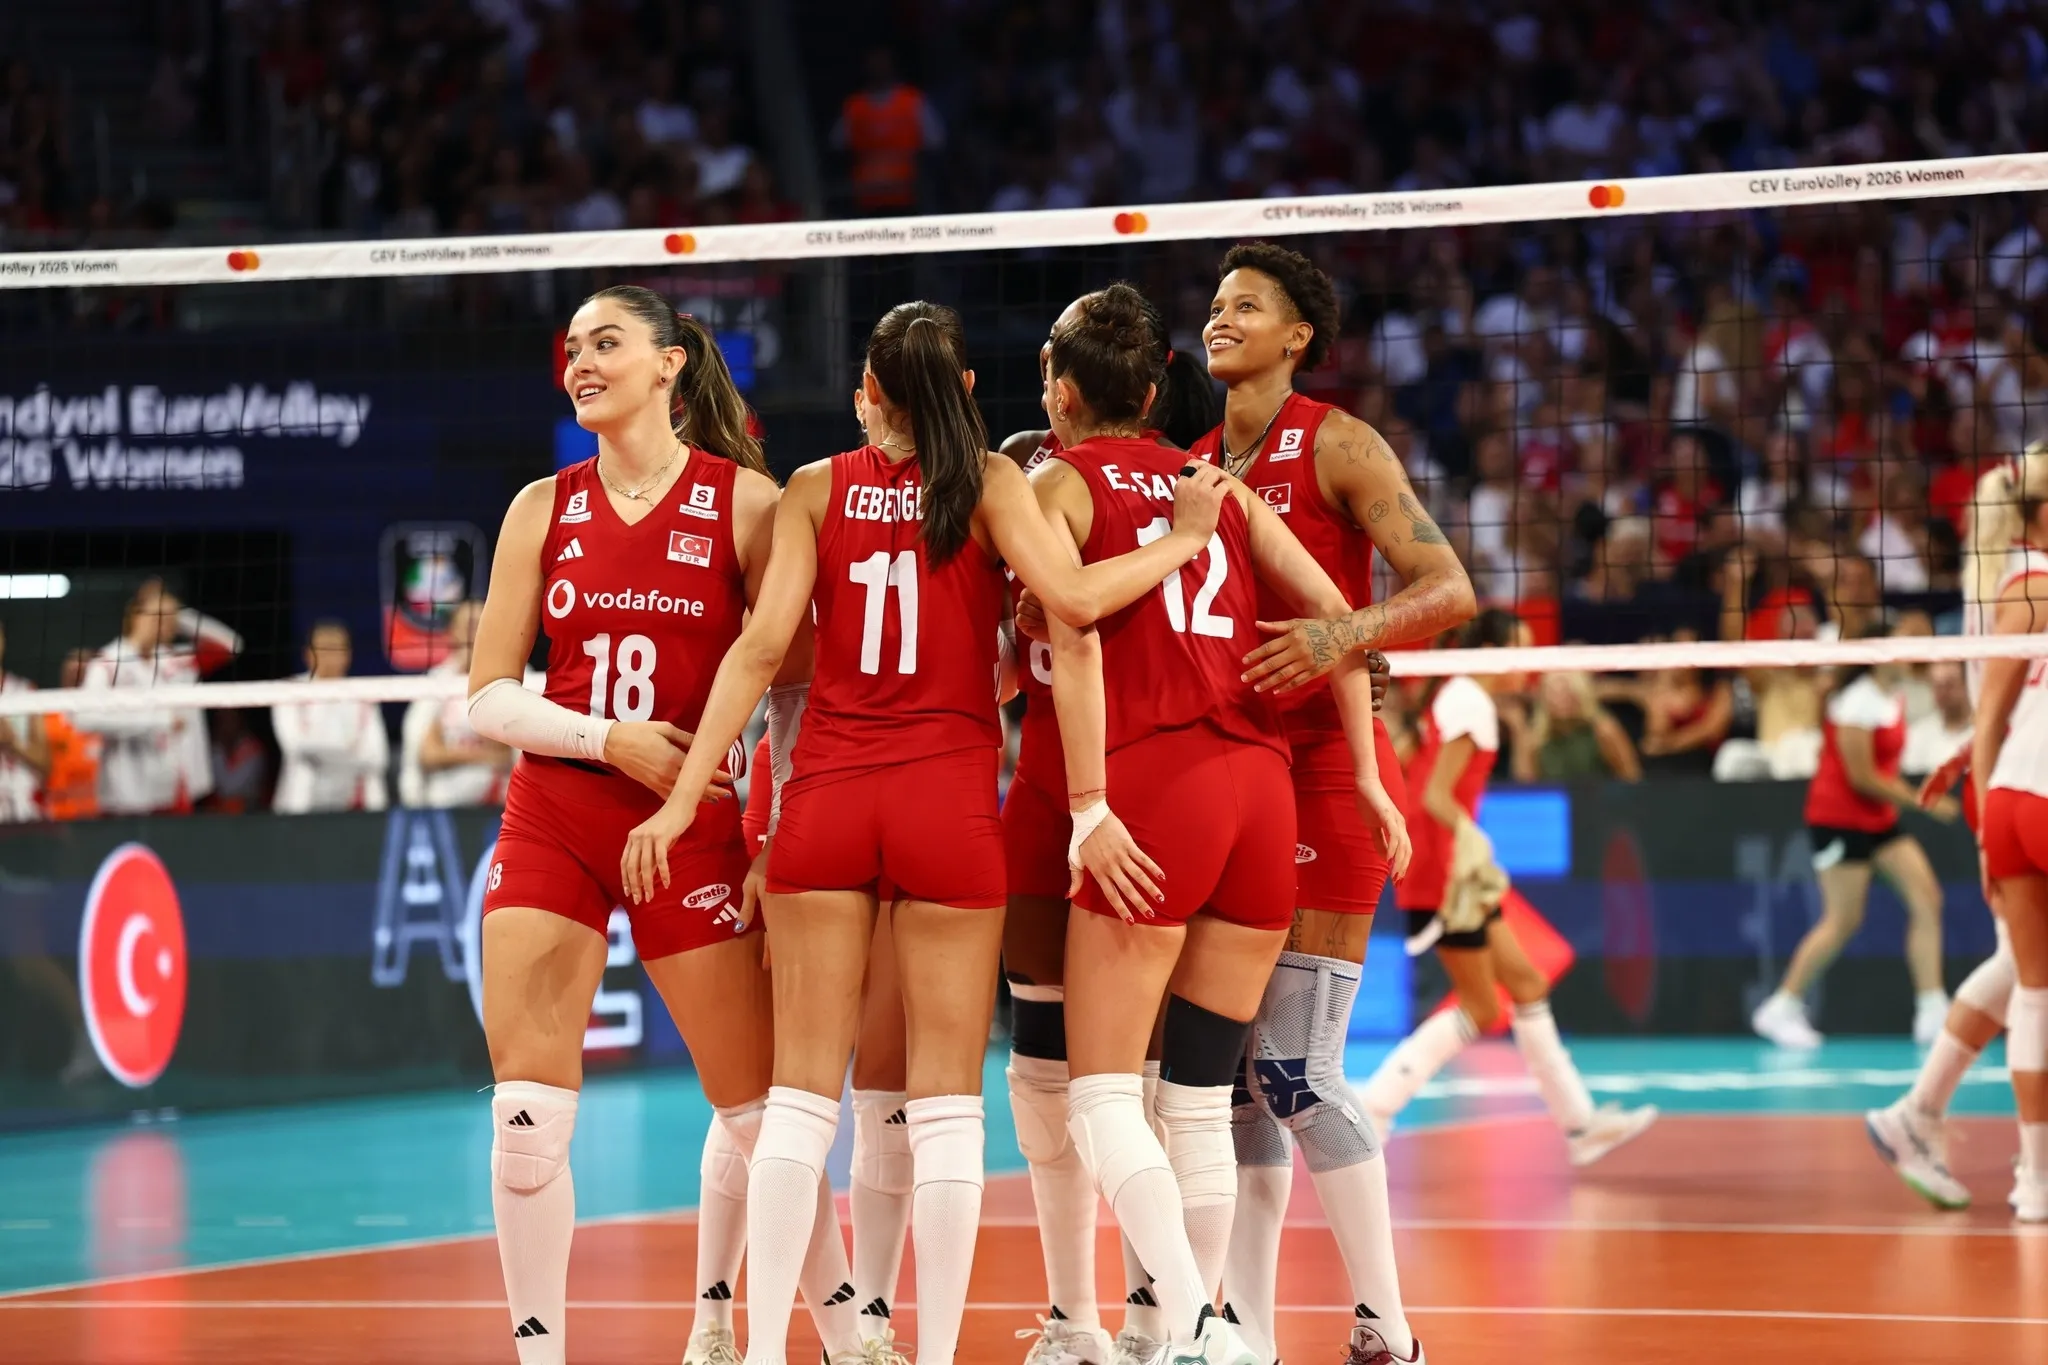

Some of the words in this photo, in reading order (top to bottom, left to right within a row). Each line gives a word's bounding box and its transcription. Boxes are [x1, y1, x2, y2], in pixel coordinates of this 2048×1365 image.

[1749, 178, 1780, 194] CEV
[1784, 171, 1862, 192] EuroVolley
[1866, 169, 1903, 187] 2026
[1906, 166, 1965, 183] Women
[1262, 206, 1293, 221] CEV
[1372, 200, 1405, 216] 2026
[1409, 199, 1463, 214] Women
[39, 260, 69, 275] 2026
[71, 259, 118, 274] Women
[129, 380, 373, 448] EuroVolley
[1285, 432, 1297, 446] S
[62, 438, 244, 490] Women
[572, 496, 583, 510] S
[695, 489, 709, 504] S
[678, 553, 700, 564] TUR
[1136, 516, 1234, 639] 12
[583, 588, 704, 617] vodafone
[849, 550, 919, 676] 11
[582, 632, 657, 723] 18
[486, 862, 503, 895] 18
[687, 884, 728, 907] gratis
